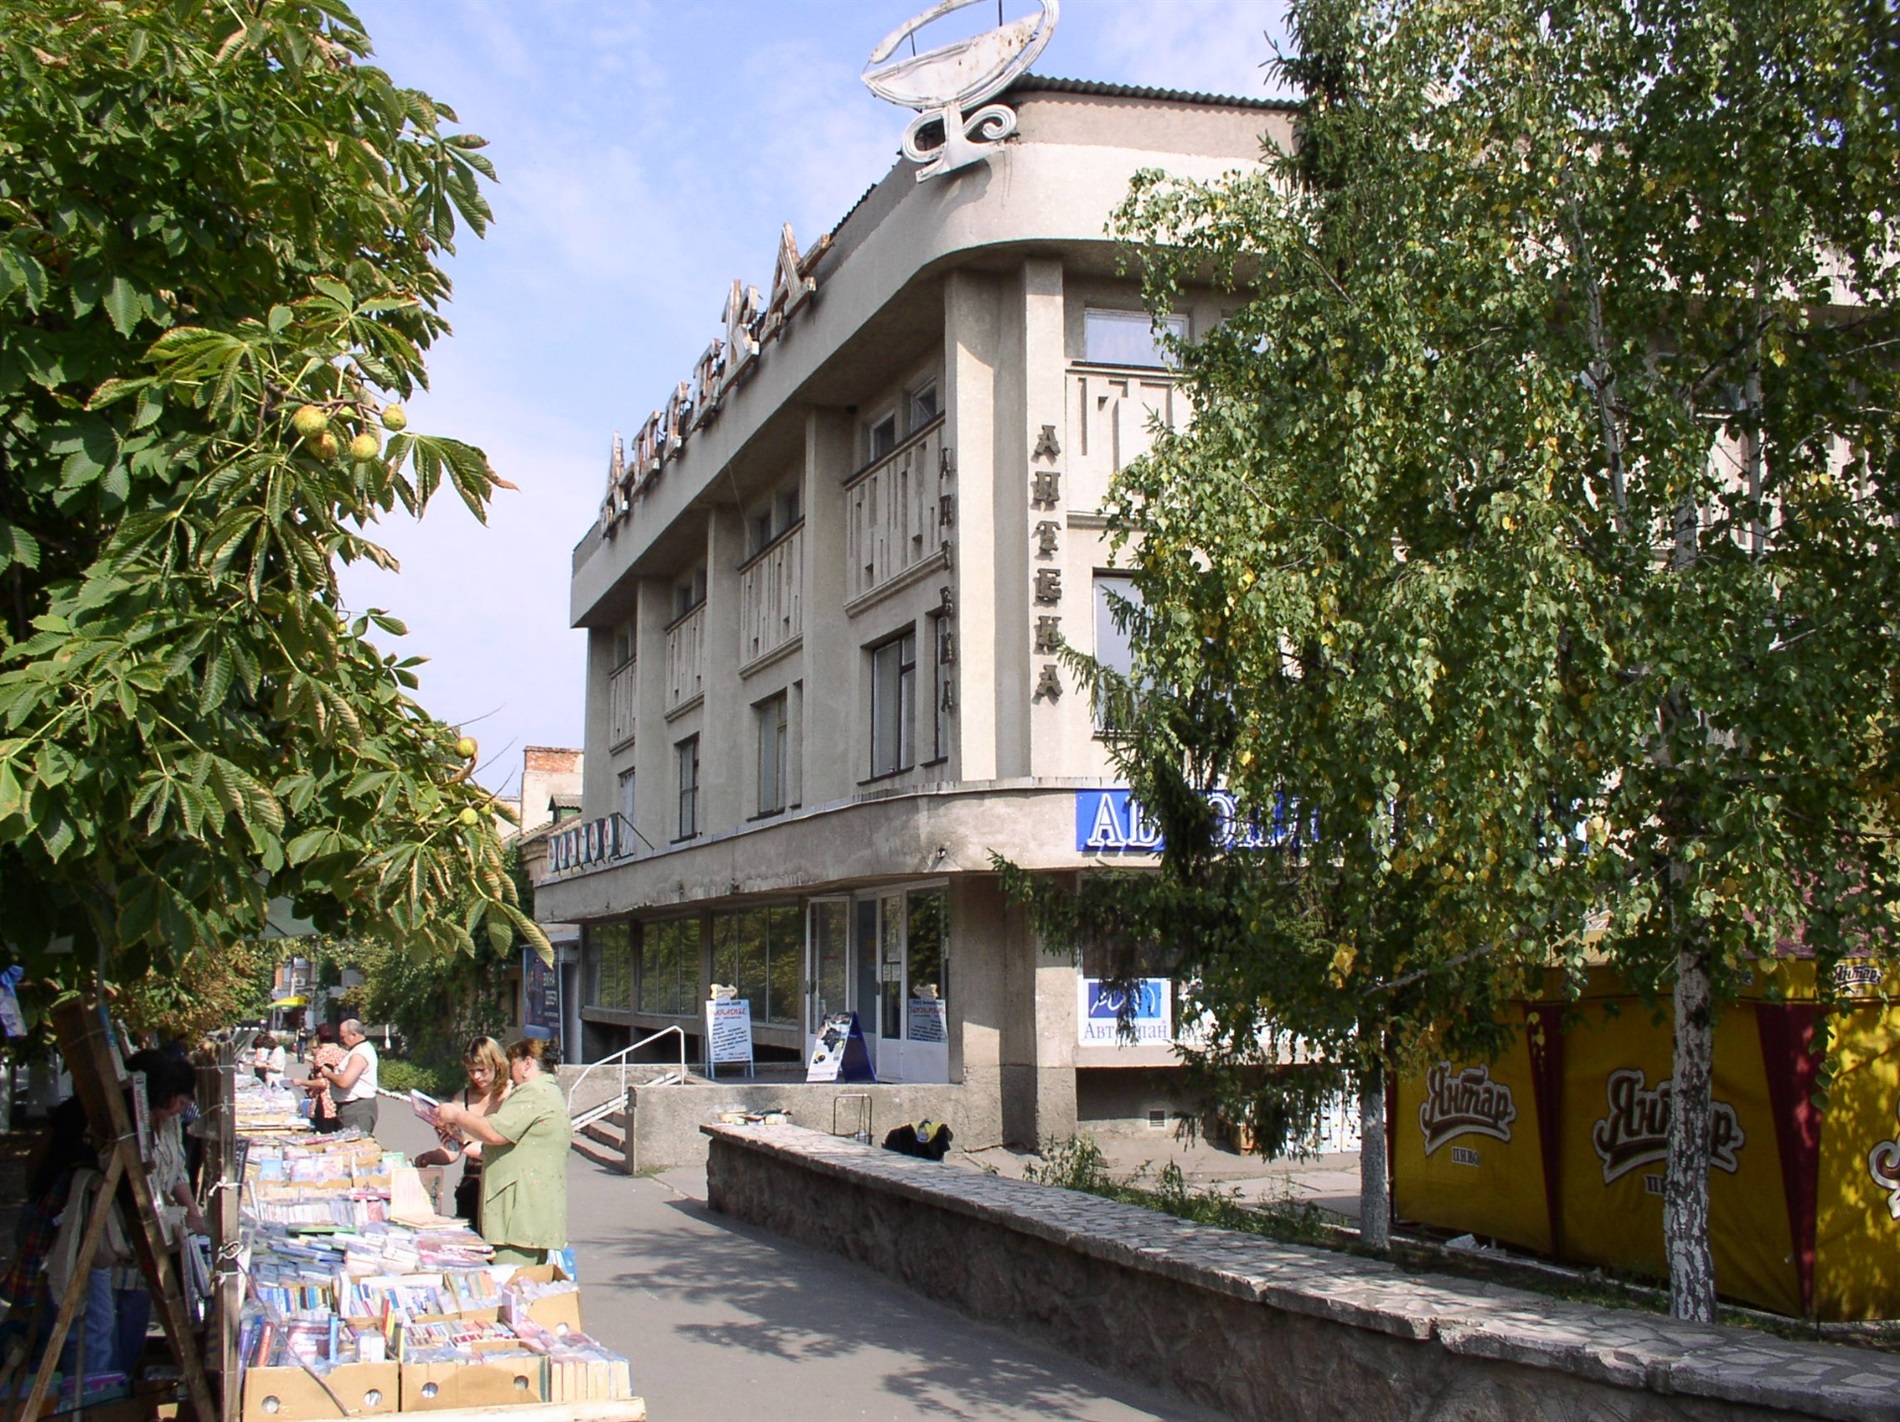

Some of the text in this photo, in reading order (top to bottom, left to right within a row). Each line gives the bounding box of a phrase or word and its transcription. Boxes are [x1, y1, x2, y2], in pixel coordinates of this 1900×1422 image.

[1032, 424, 1064, 703] АПТЕКА
[1419, 1061, 1516, 1133] Янтар
[1594, 1070, 1743, 1160] Янр
